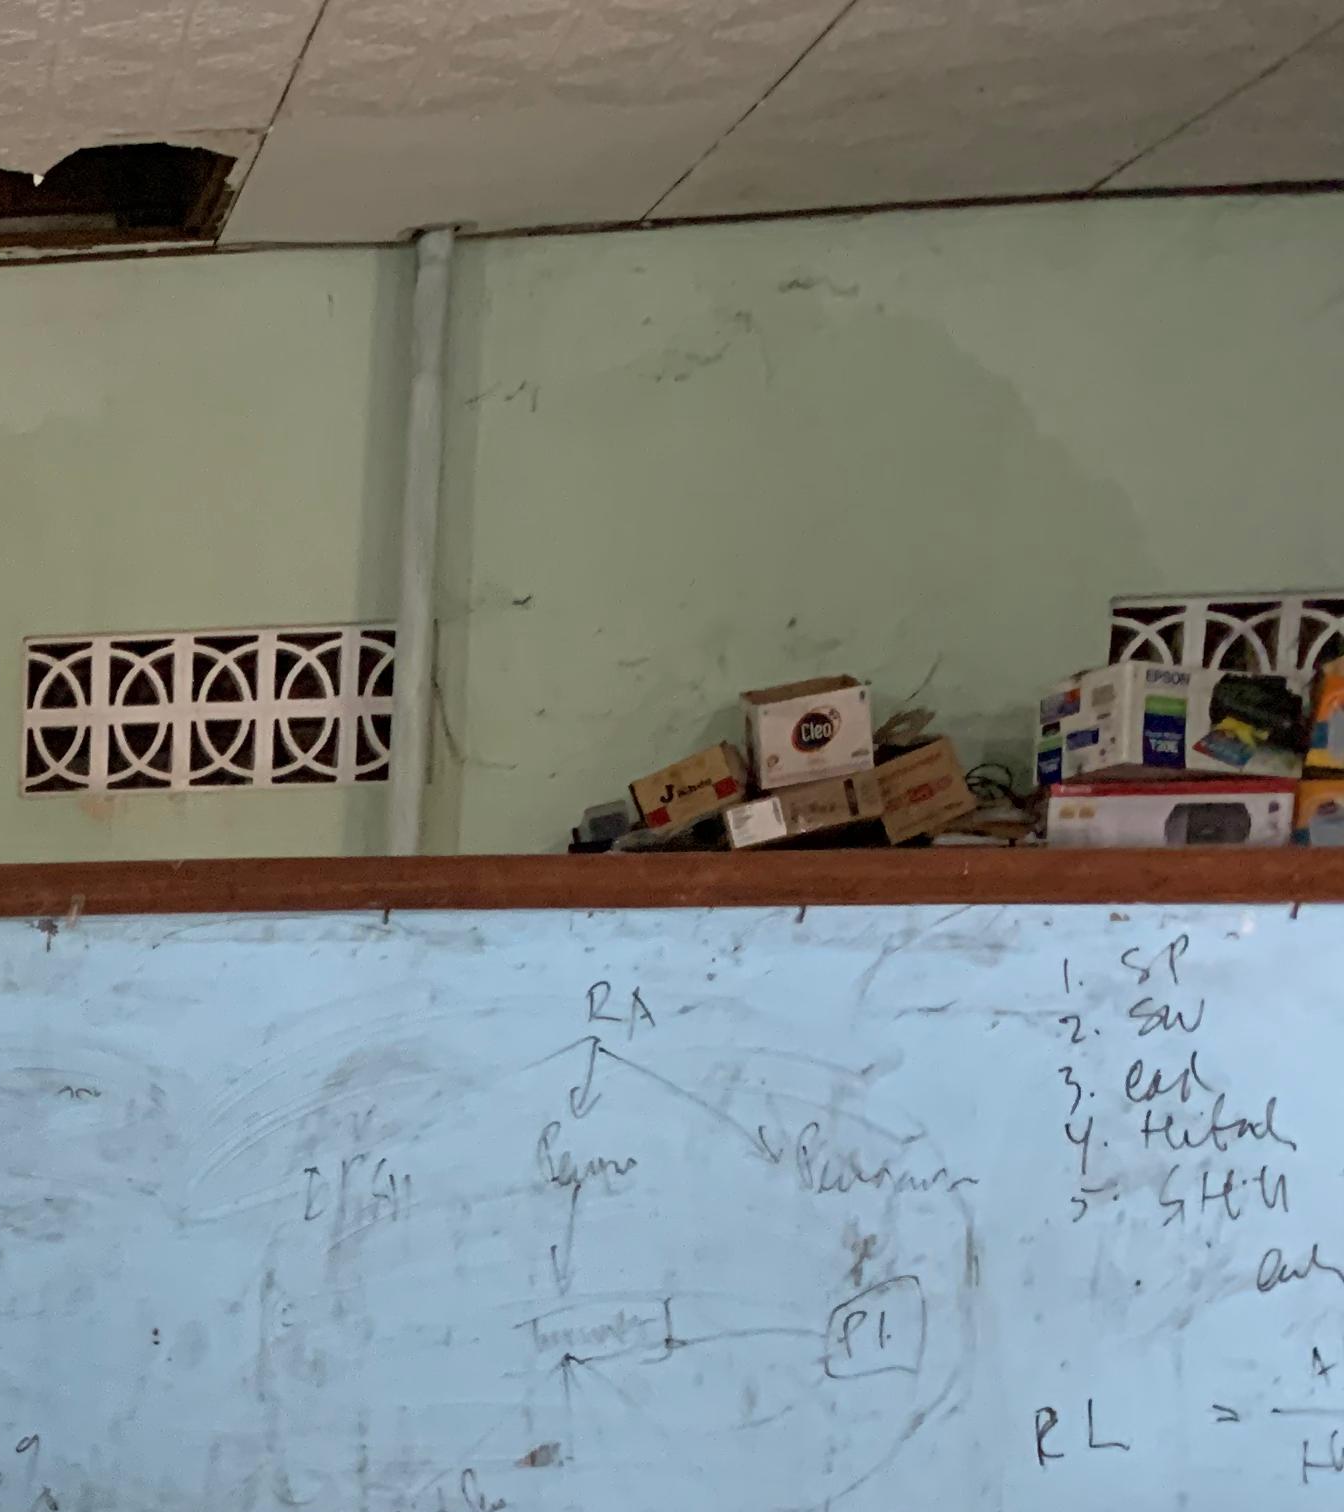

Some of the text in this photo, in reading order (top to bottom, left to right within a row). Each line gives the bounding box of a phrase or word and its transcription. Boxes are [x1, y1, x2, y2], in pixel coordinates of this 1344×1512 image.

[1146, 669, 1191, 685] EPSON
[801, 721, 832, 742] Cleo
[1121, 934, 1189, 985] SP
[587, 980, 656, 1040] RA
[1059, 1014, 1100, 1044] 2.
[1058, 1066, 1095, 1115] 3.
